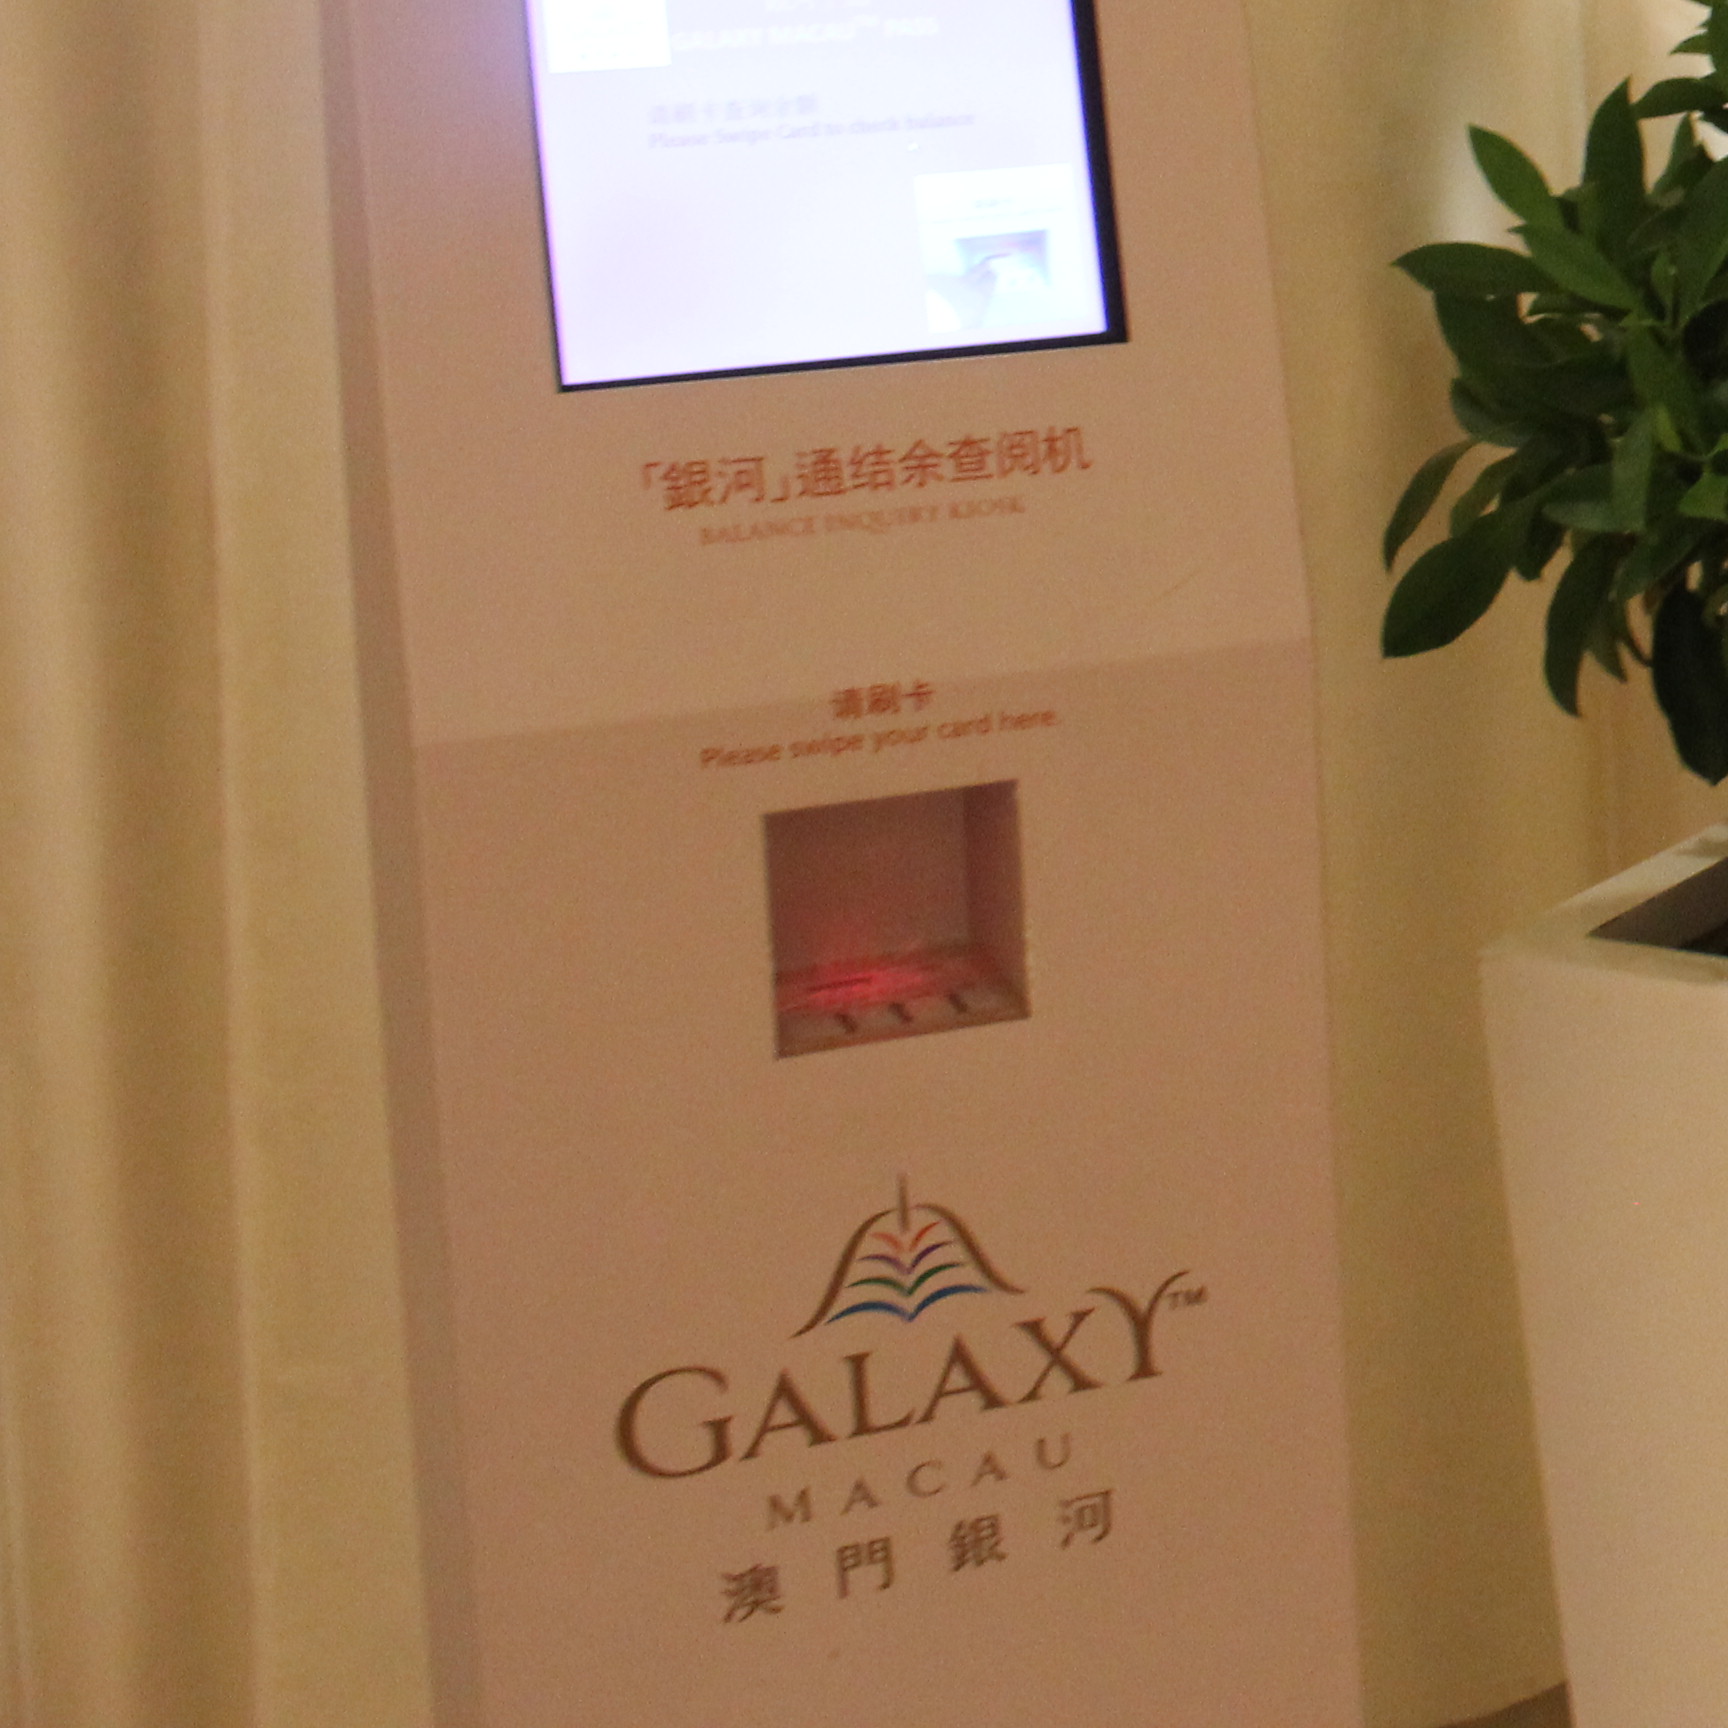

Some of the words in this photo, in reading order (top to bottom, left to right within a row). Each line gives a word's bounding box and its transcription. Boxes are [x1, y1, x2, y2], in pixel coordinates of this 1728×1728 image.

[765, 1432, 1073, 1530] MACAU
[722, 1488, 1115, 1624] 澳門銀河
